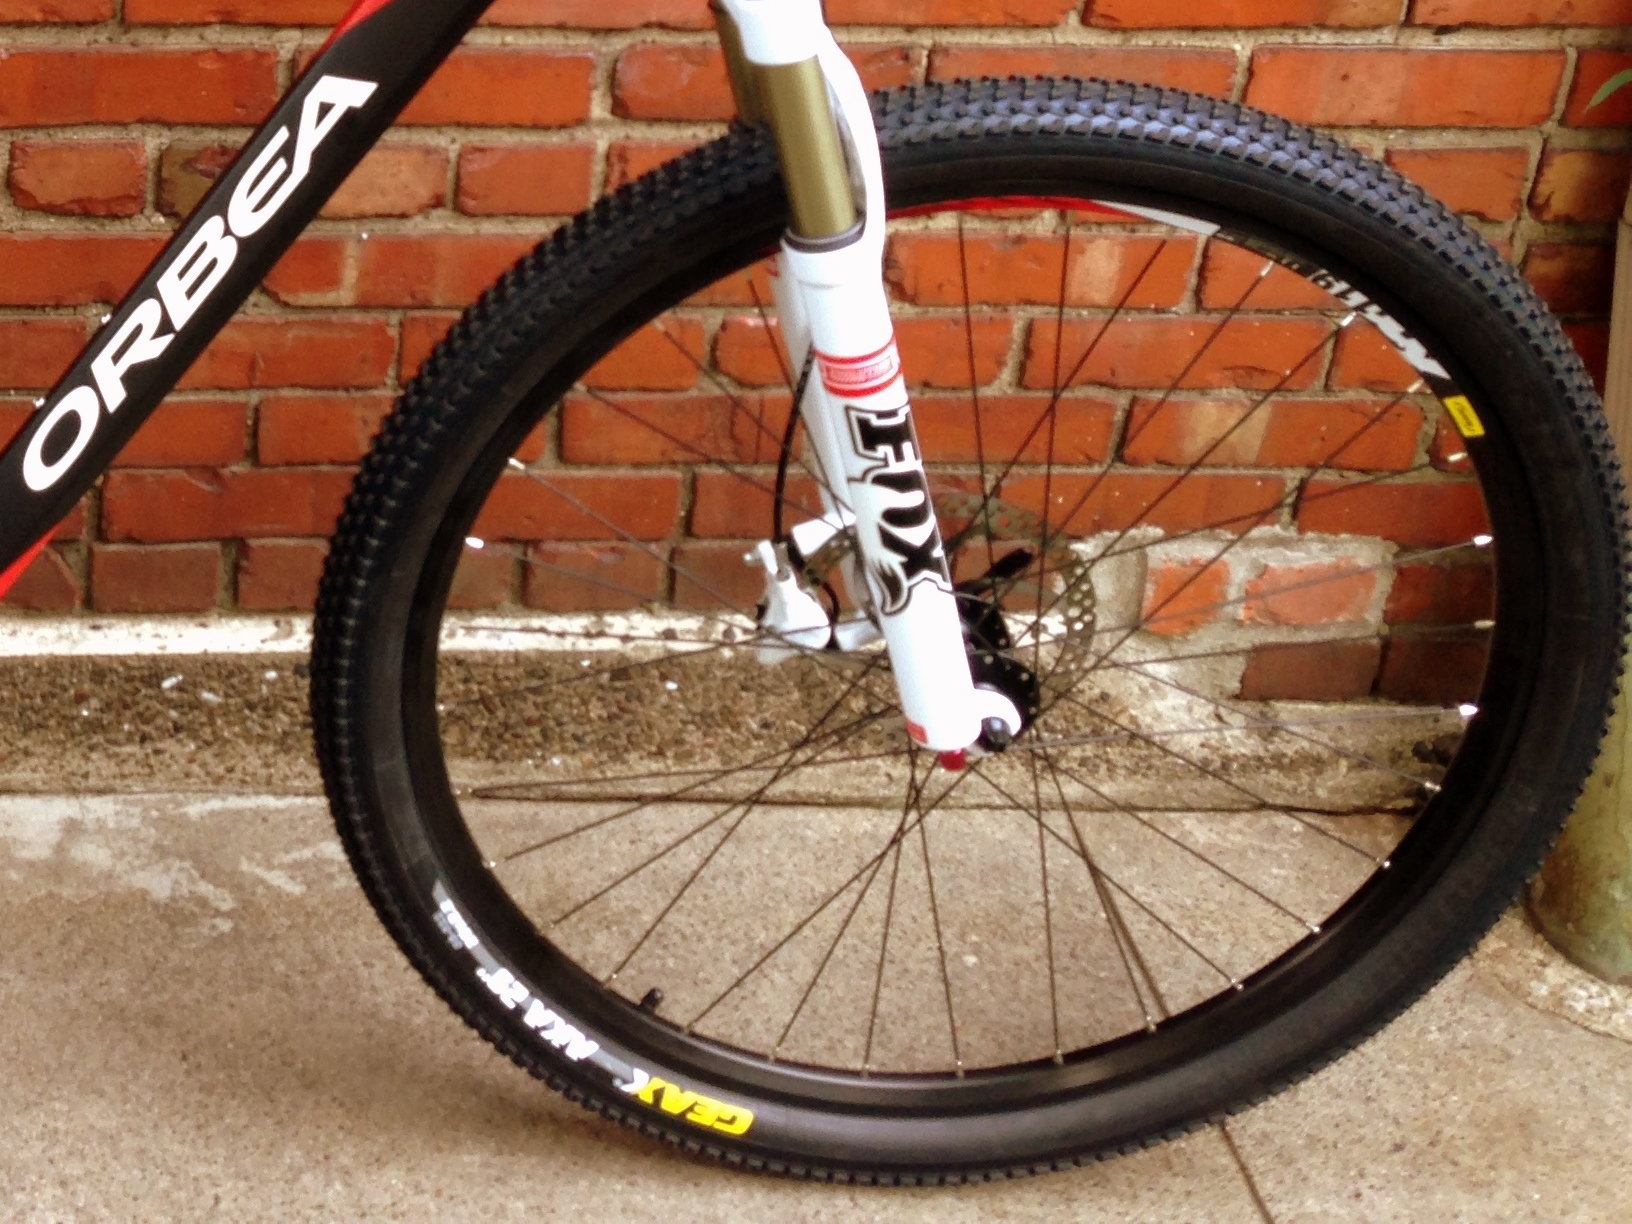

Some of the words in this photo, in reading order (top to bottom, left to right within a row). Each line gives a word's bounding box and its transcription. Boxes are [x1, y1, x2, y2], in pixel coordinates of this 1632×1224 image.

[22, 74, 379, 493] ORBEA
[522, 997, 600, 1062] AKA
[619, 1067, 755, 1136] GEAX
